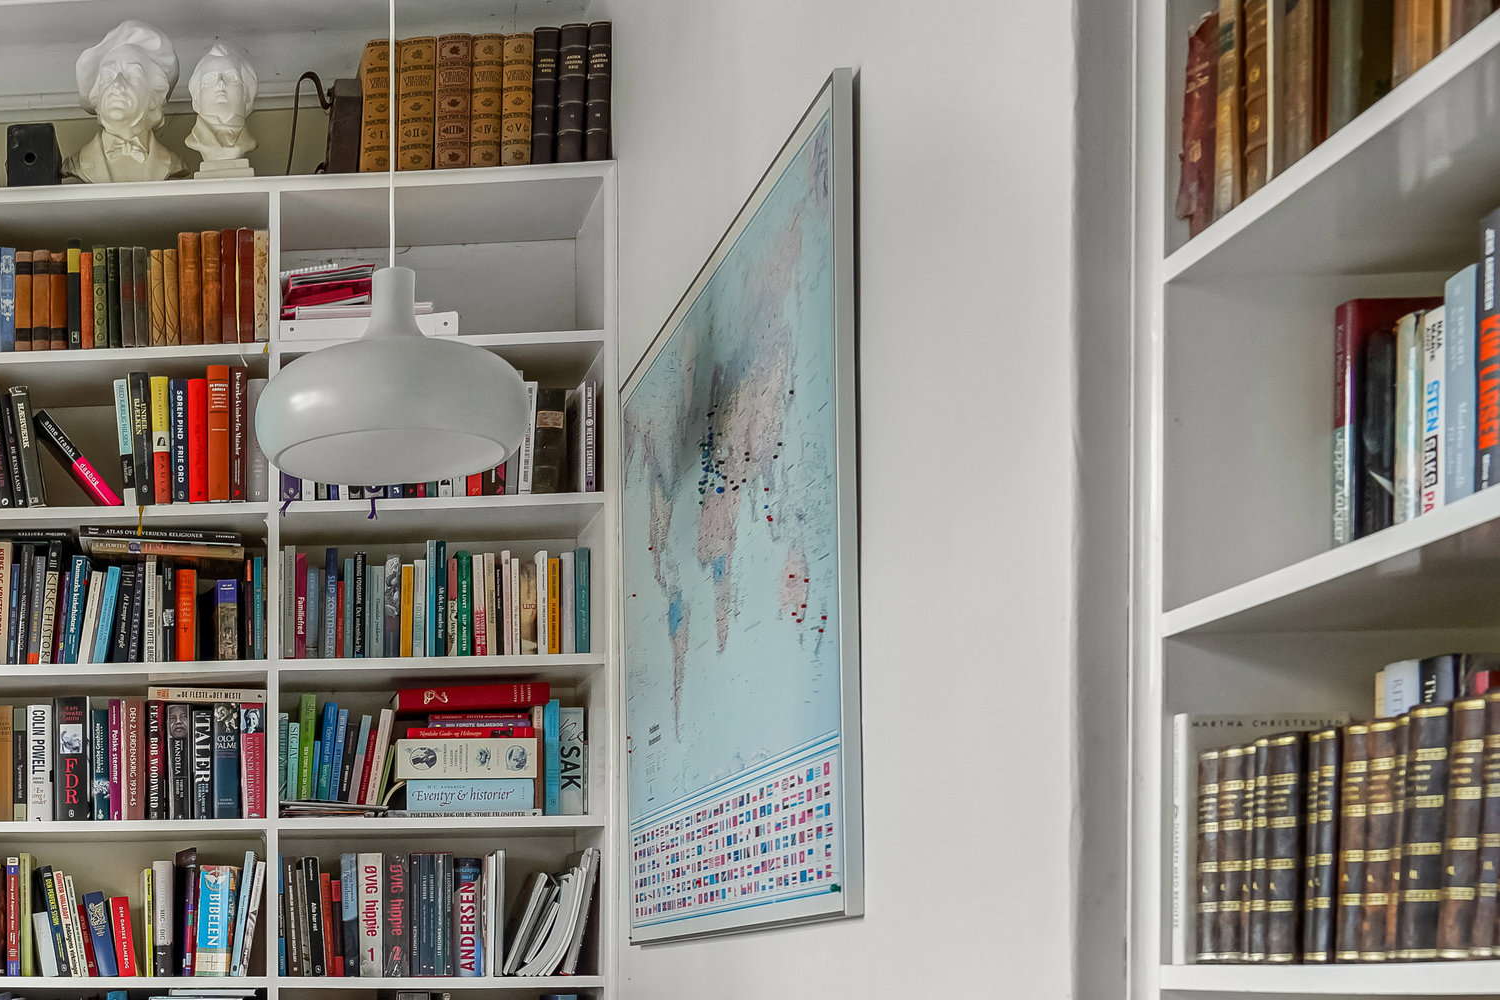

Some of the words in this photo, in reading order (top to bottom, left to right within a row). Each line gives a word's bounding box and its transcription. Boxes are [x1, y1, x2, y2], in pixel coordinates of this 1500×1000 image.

[1480, 315, 1500, 361] KIM
[1425, 380, 1440, 432] STEN
[1478, 366, 1500, 450] LARSEN
[18, 402, 30, 448] HÆRVÆRK
[43, 420, 59, 436] anne
[58, 436, 76, 457] franks
[79, 463, 100, 487] dagbog
[73, 559, 82, 591] Danmarks
[70, 592, 80, 633] kirkehistorie
[297, 597, 305, 634] Familiefred
[32, 709, 45, 737] COLIN
[129, 707, 137, 720] DEN
[150, 705, 158, 732] FEAR
[32, 739, 46, 774] POWELL
[111, 729, 119, 753] Polske
[150, 737, 159, 756] BOB
[194, 717, 211, 783] TALER
[65, 758, 79, 805] FDR
[149, 758, 158, 808] WOODWARD
[561, 745, 582, 792] SAK
[412, 789, 455, 807] Eventyr
[469, 788, 515, 801] historier
[45, 879, 53, 887] DEN
[365, 865, 377, 894] ØVIG
[390, 865, 402, 893] ØVIG
[46, 888, 57, 912] PERFEKTE
[389, 899, 403, 936] hippie
[50, 913, 60, 926] STORM
[207, 893, 220, 946] BIBELEN
[363, 900, 379, 936] hippie
[459, 883, 476, 971] ANDERSEN
[121, 941, 130, 969] SALMEBOG
[392, 946, 400, 961] 2
